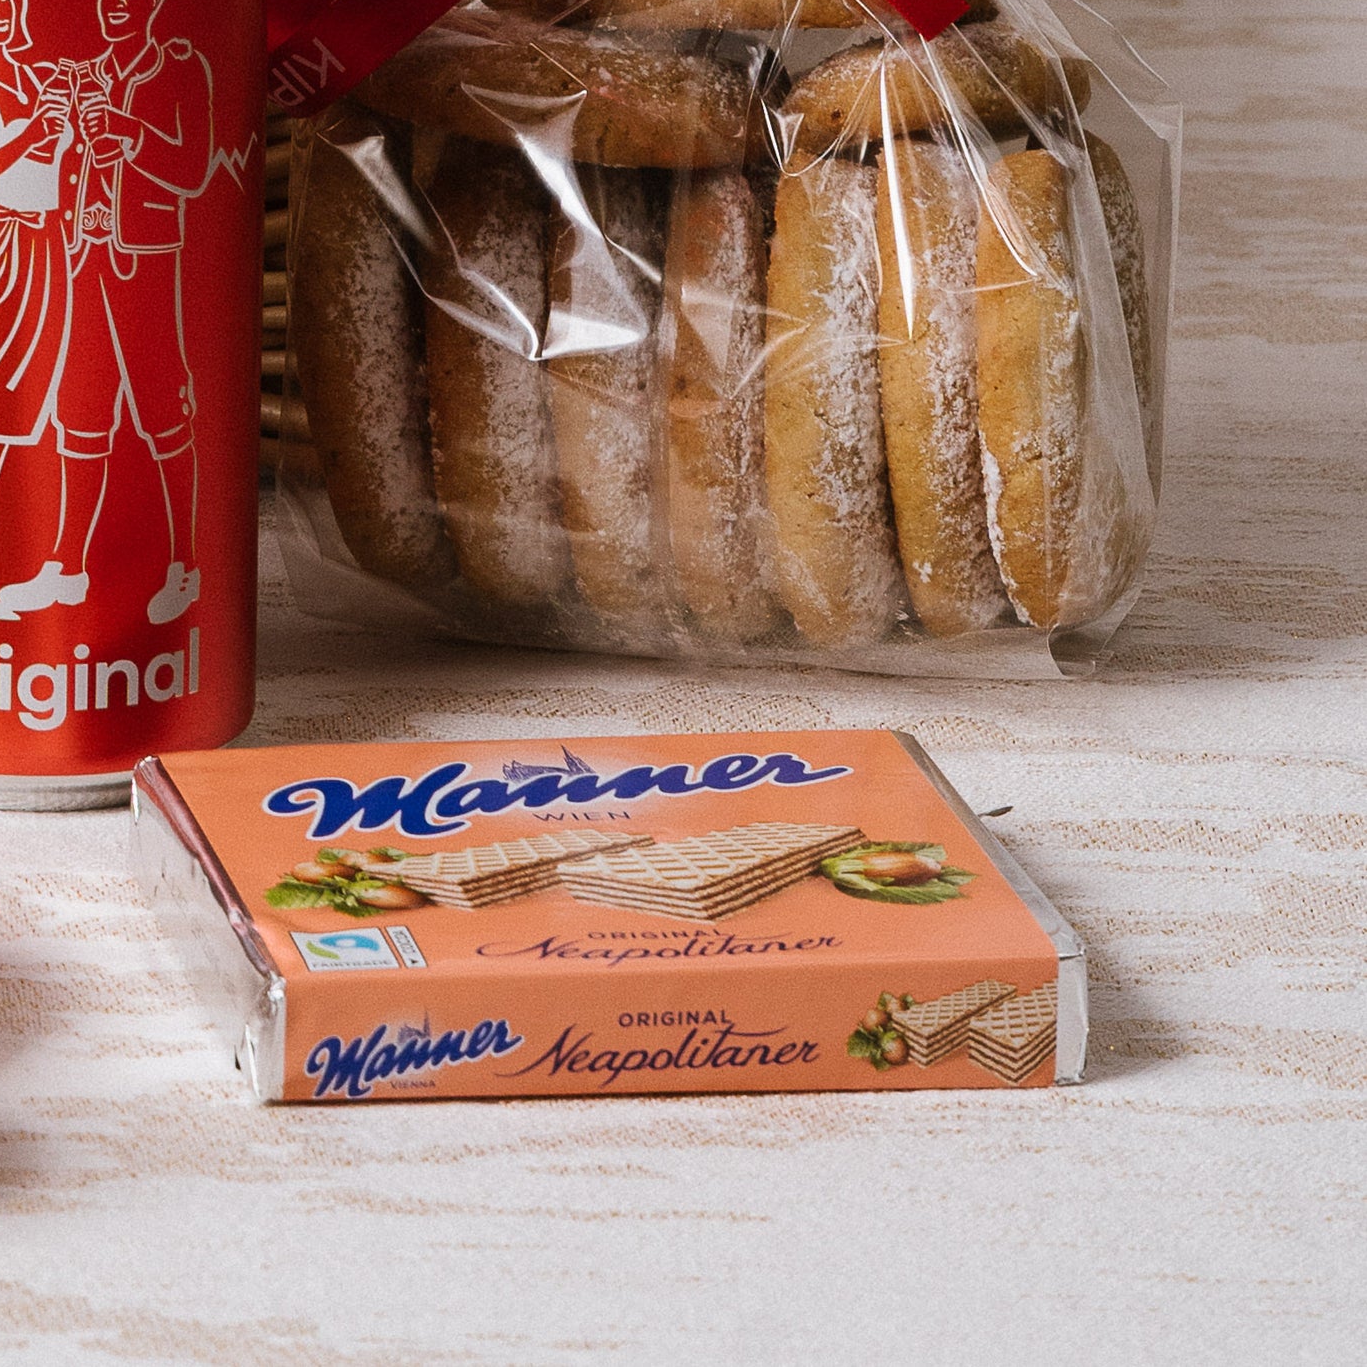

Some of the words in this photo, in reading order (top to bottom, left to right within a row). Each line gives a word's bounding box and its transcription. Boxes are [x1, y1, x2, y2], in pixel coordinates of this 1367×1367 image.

[267, 752, 850, 839] Manner
[532, 809, 631, 823] WIEN
[474, 927, 844, 967] Neapolitaner
[587, 927, 722, 942] ORIGINAL
[618, 1009, 733, 1029] ORIGINAL
[306, 1019, 523, 1097] Manner
[494, 1023, 820, 1089] Neapolitaner
[391, 1079, 437, 1091] VIENNA
